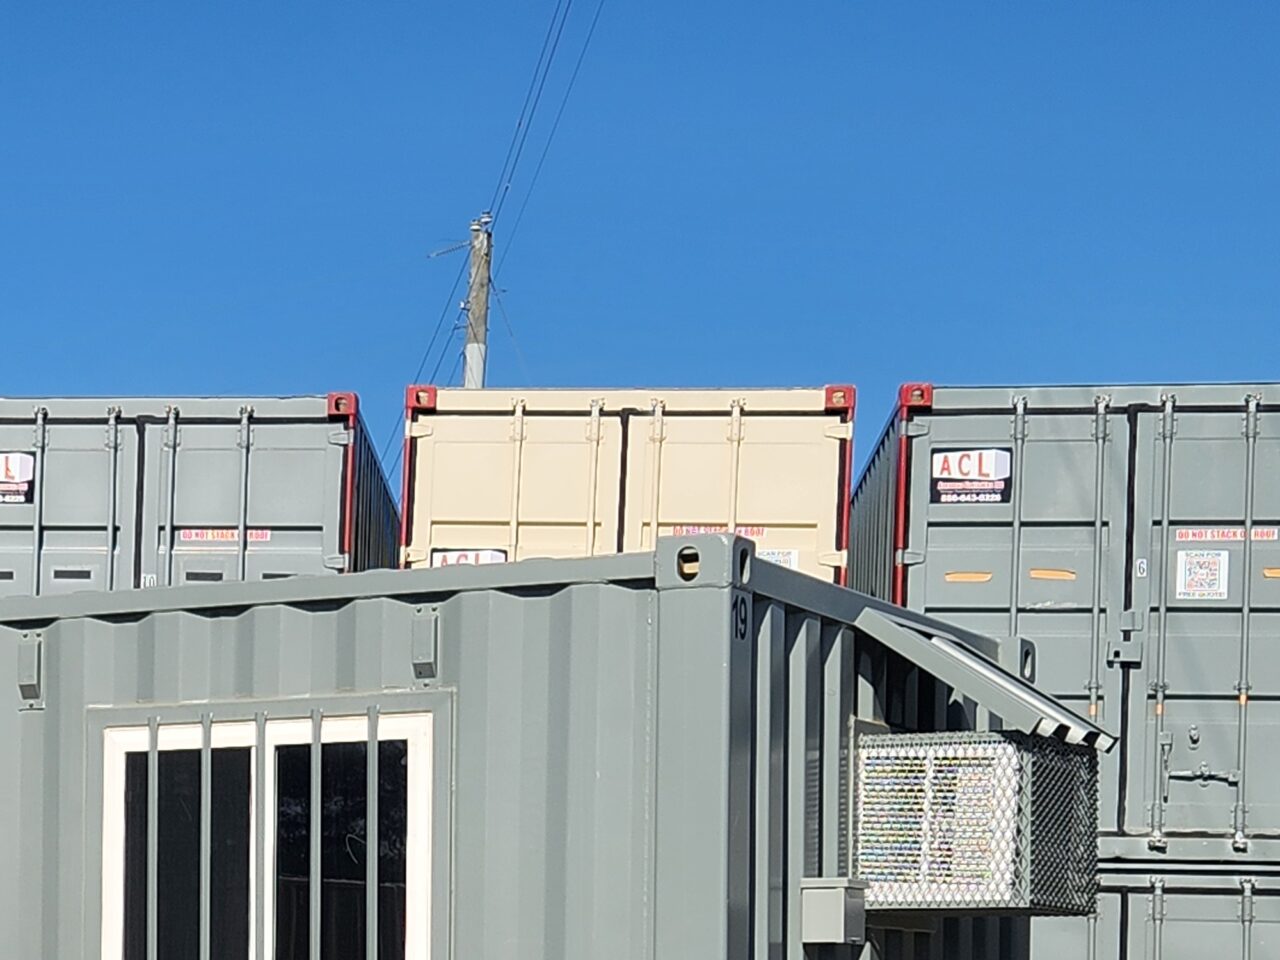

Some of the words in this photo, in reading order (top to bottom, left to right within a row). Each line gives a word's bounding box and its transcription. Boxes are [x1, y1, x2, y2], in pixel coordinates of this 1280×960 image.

[940, 452, 990, 478] ACL
[1178, 531, 1189, 539] DO
[1192, 531, 1207, 539] NOT
[1210, 531, 1237, 539] STACK
[1138, 561, 1145, 576] 6
[732, 595, 748, 640] 19
